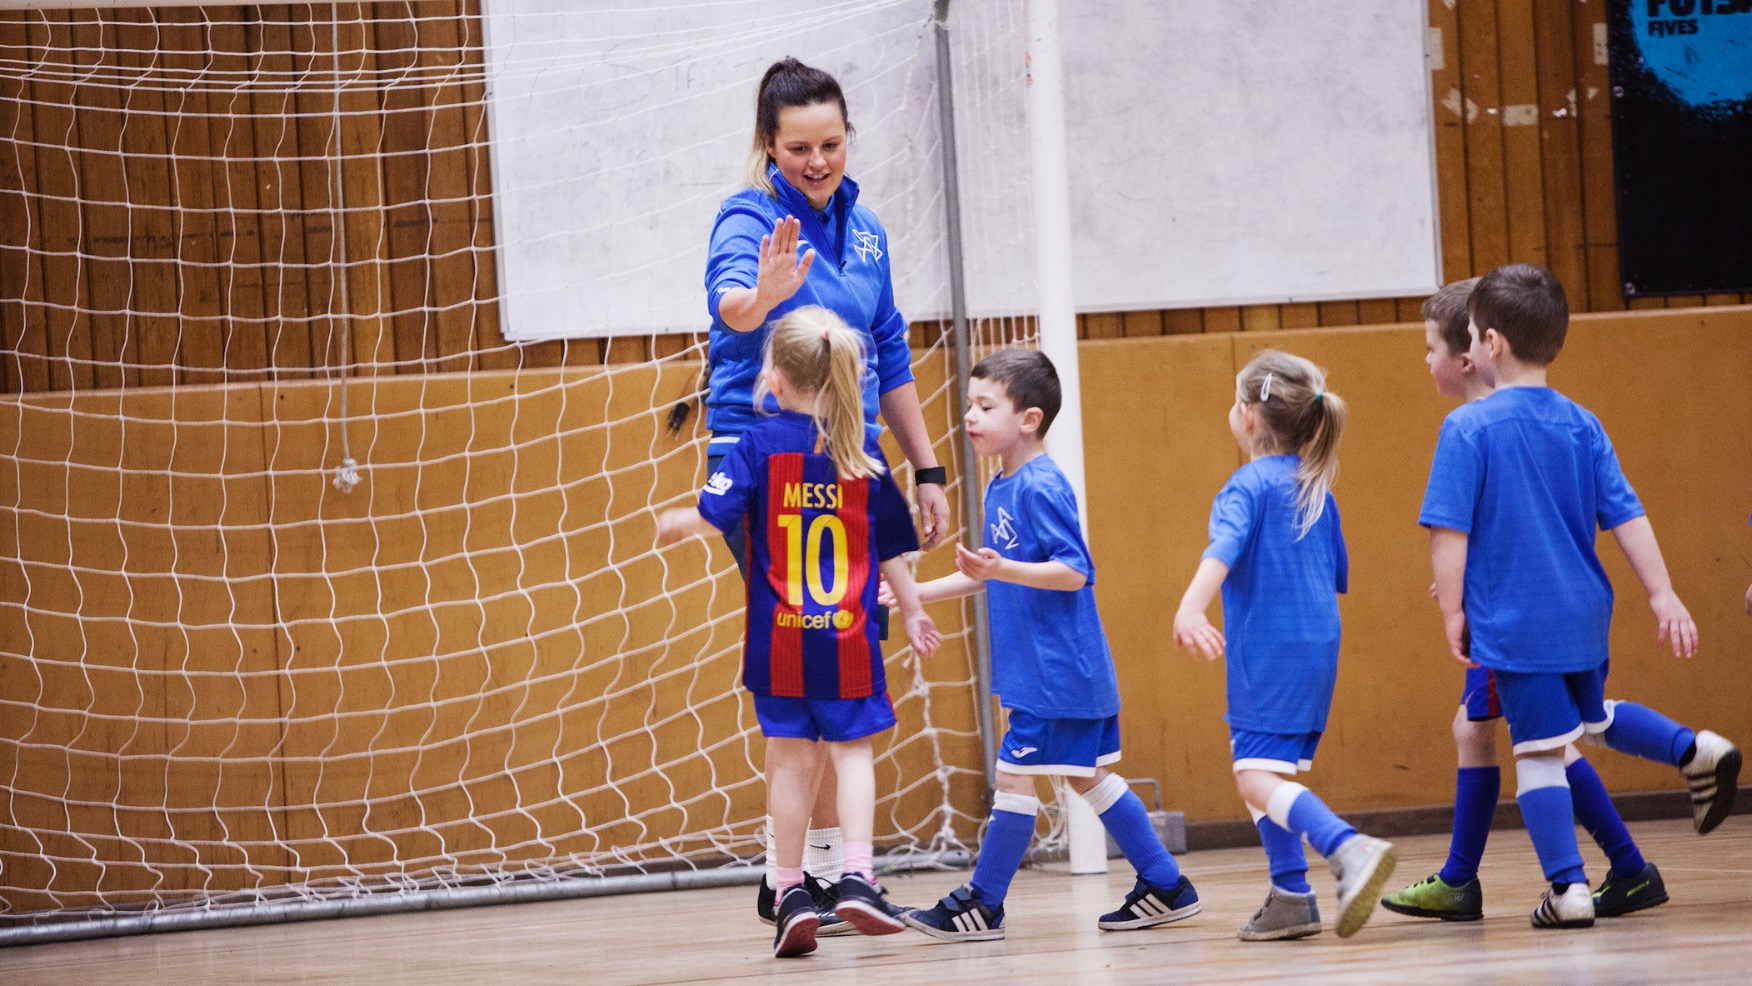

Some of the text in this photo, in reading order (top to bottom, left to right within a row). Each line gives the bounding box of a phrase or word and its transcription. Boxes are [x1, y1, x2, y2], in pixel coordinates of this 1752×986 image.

[1648, 19, 1699, 37] FIVES
[783, 482, 843, 509] MESSI
[777, 514, 849, 606] 10
[777, 611, 831, 629] unicef
